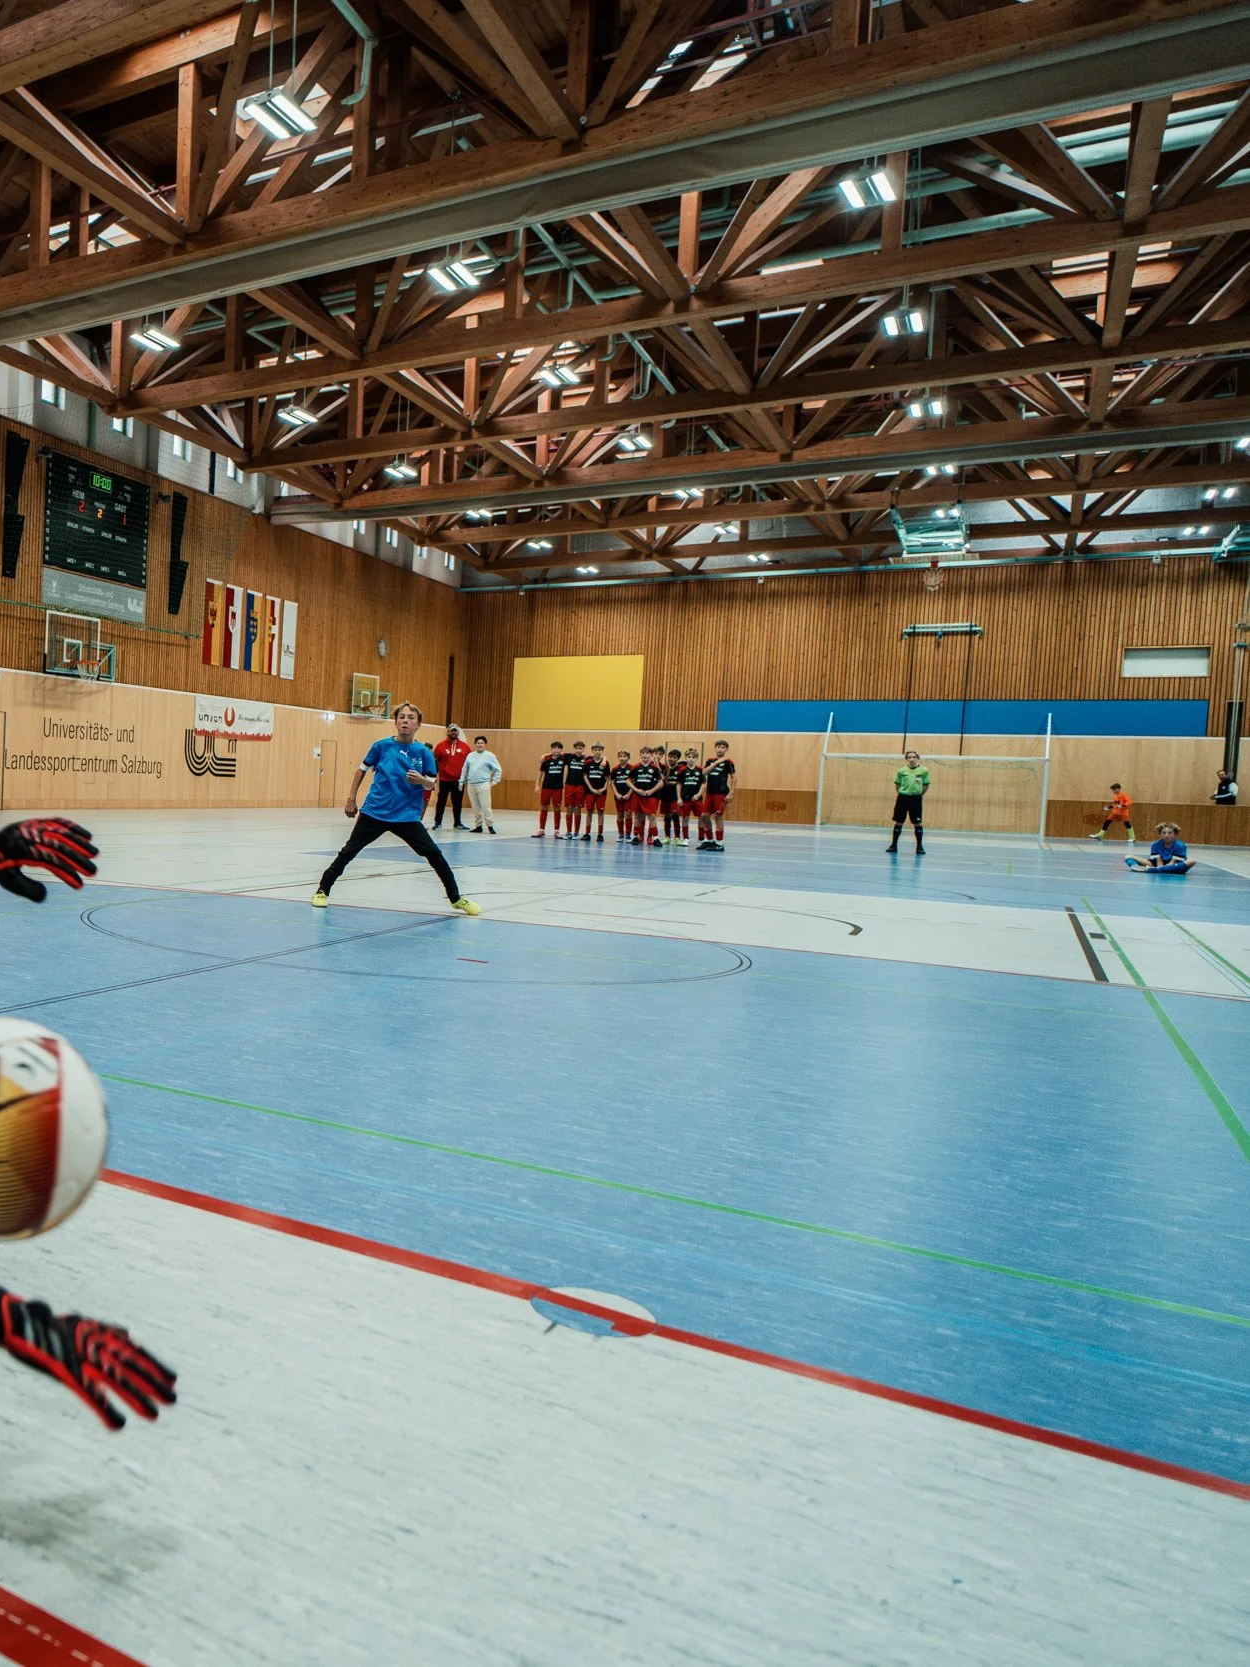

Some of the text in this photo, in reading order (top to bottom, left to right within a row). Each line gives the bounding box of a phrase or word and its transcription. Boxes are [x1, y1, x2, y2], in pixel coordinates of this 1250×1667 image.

[93, 474, 111, 490] 10:00
[78, 500, 85, 513] 2
[97, 508, 103, 519] 2
[43, 717, 135, 743] Universitäts- und
[4, 748, 162, 779] Landessportzentrum Salzburg
